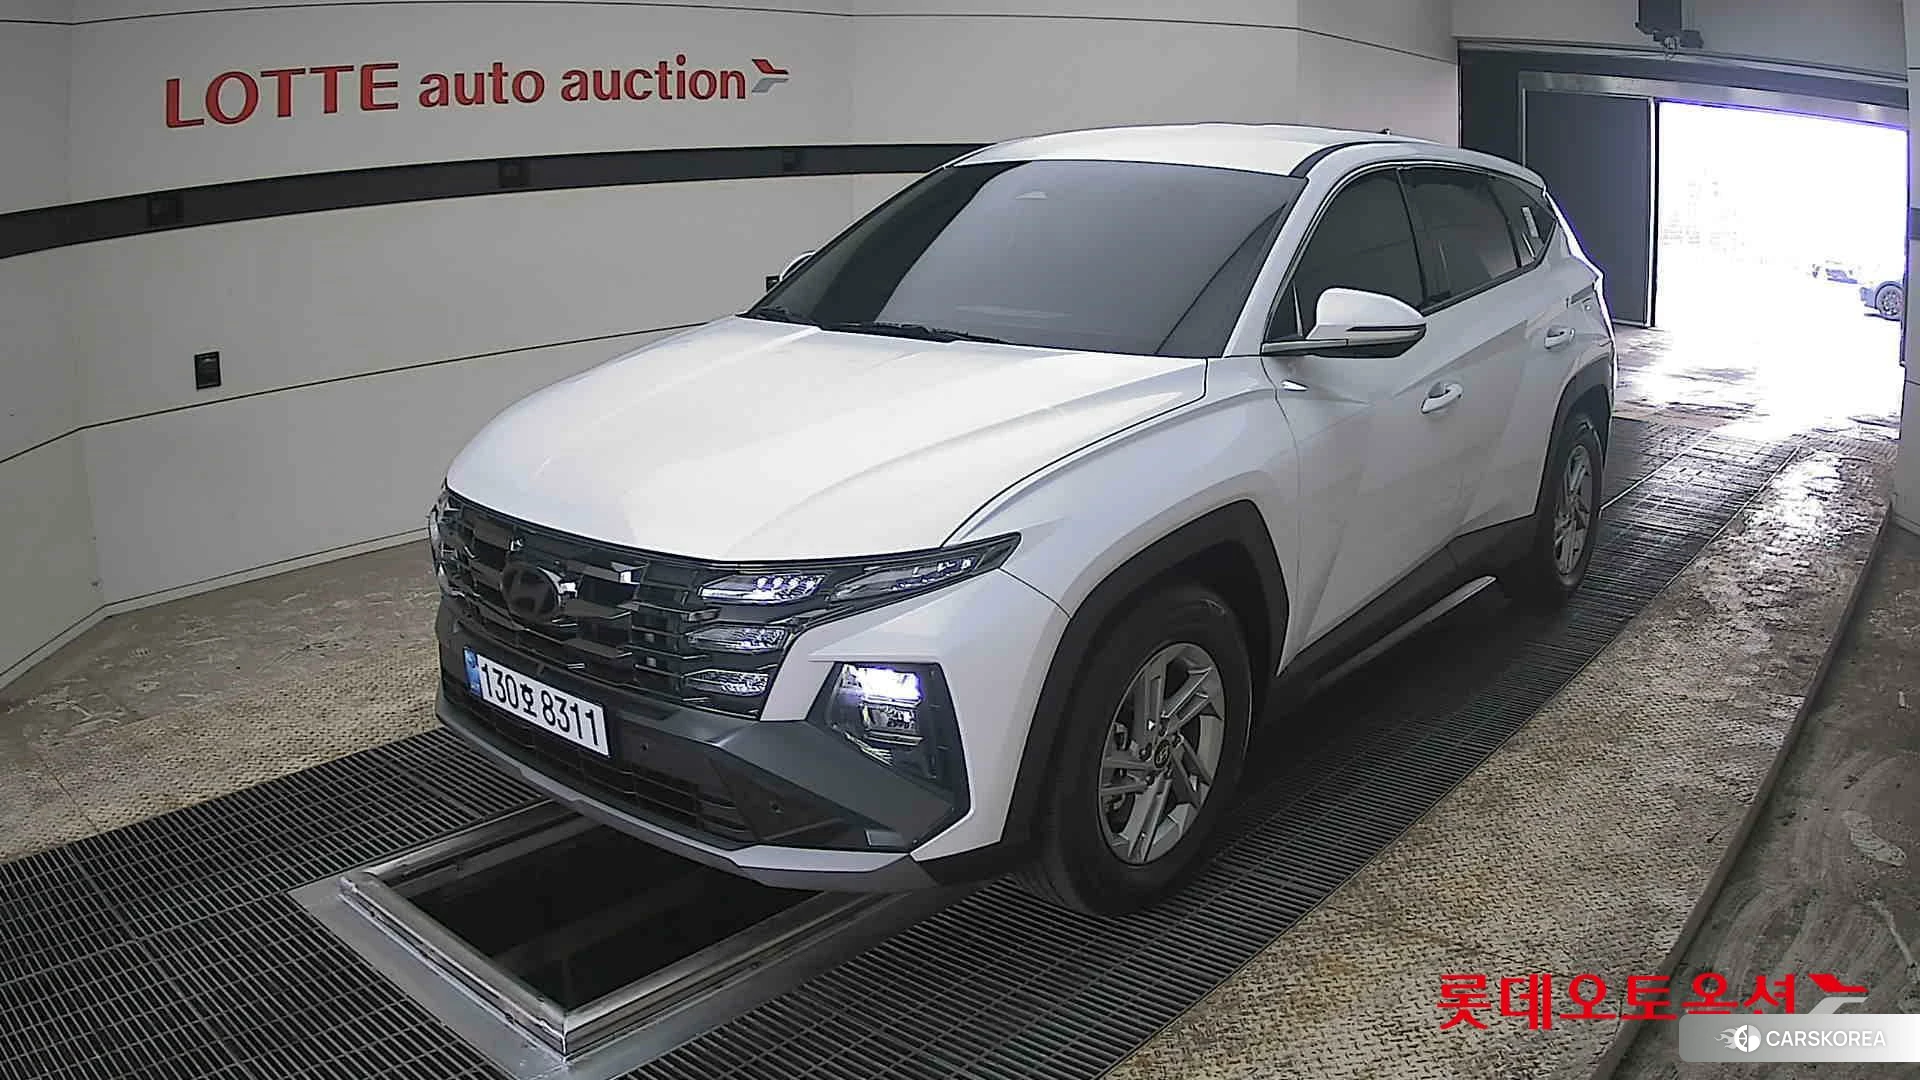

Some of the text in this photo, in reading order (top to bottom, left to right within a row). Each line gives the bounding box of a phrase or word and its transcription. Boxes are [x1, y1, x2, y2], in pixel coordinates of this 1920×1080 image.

[165, 54, 746, 128] LOTTE auto auction
[482, 663, 598, 746] 130호 8311
